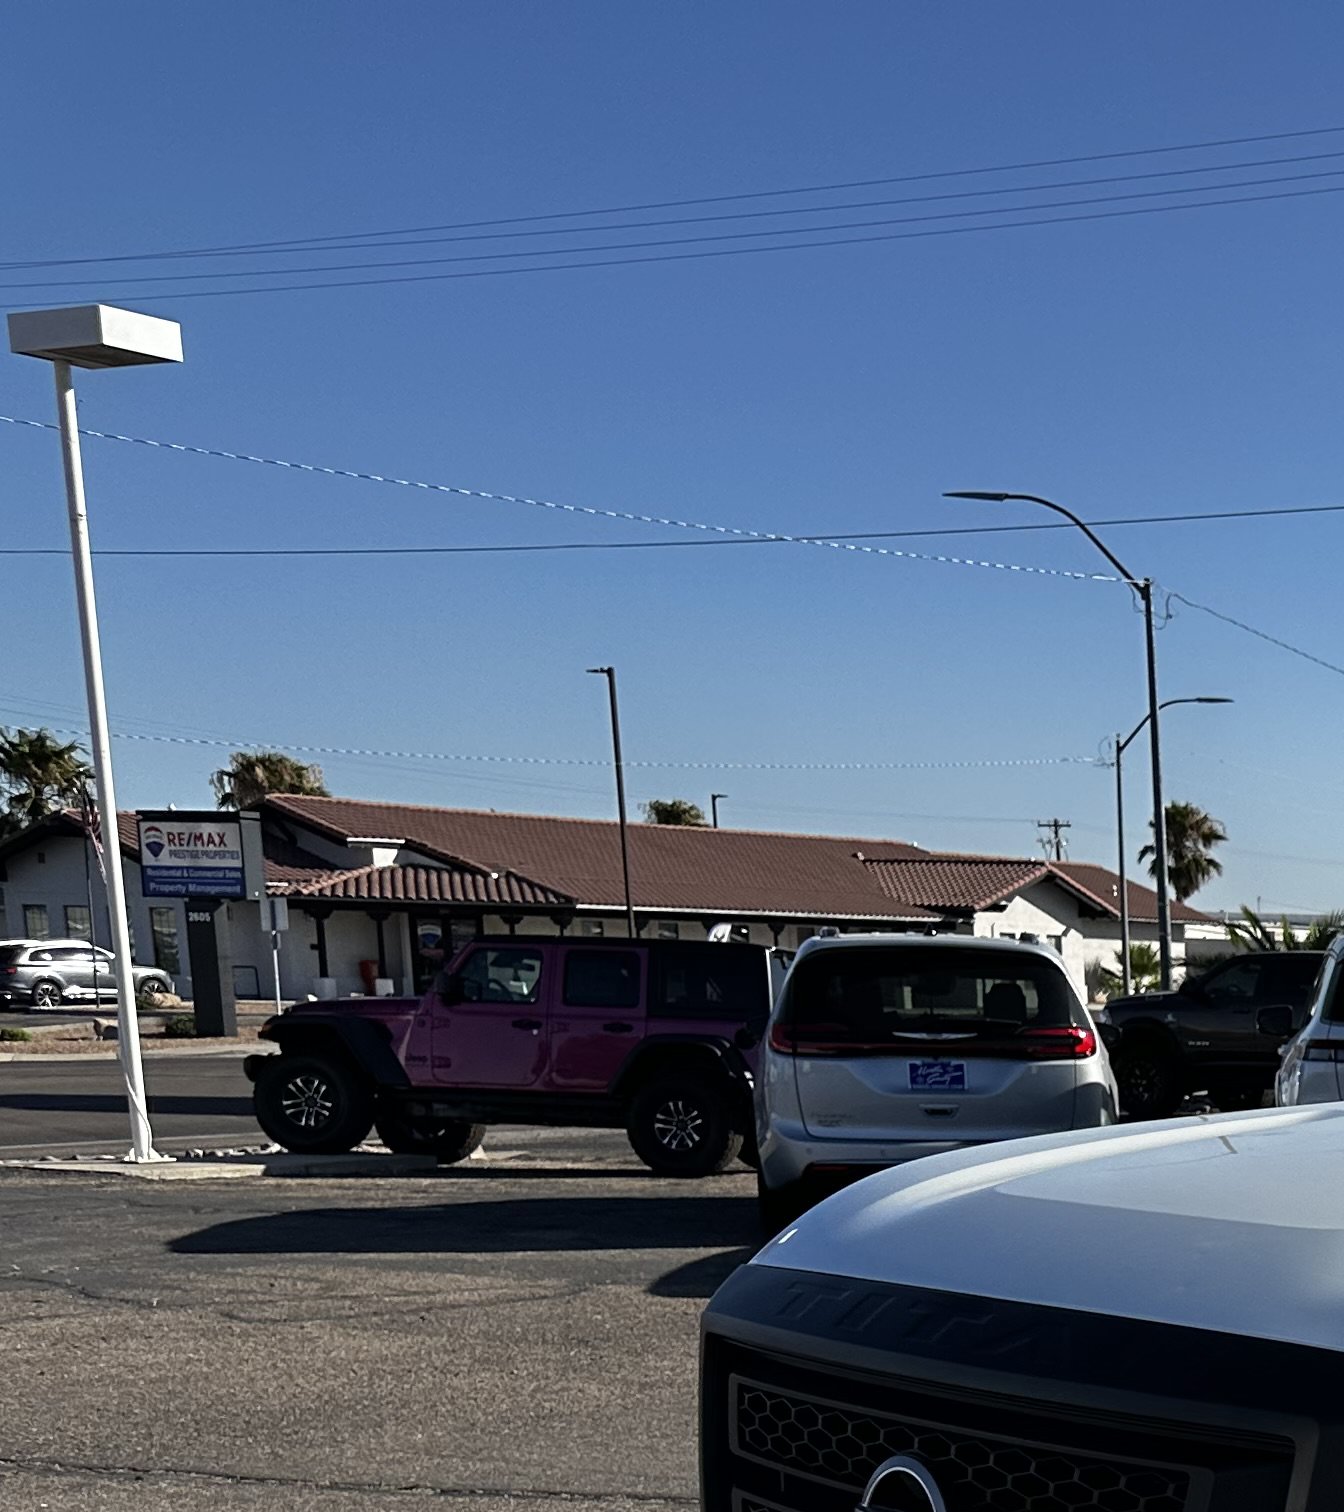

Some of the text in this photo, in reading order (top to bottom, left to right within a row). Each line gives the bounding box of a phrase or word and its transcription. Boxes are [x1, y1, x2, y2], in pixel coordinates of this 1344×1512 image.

[166, 831, 228, 848] RE/MAX
[150, 882, 241, 894] Property Management
